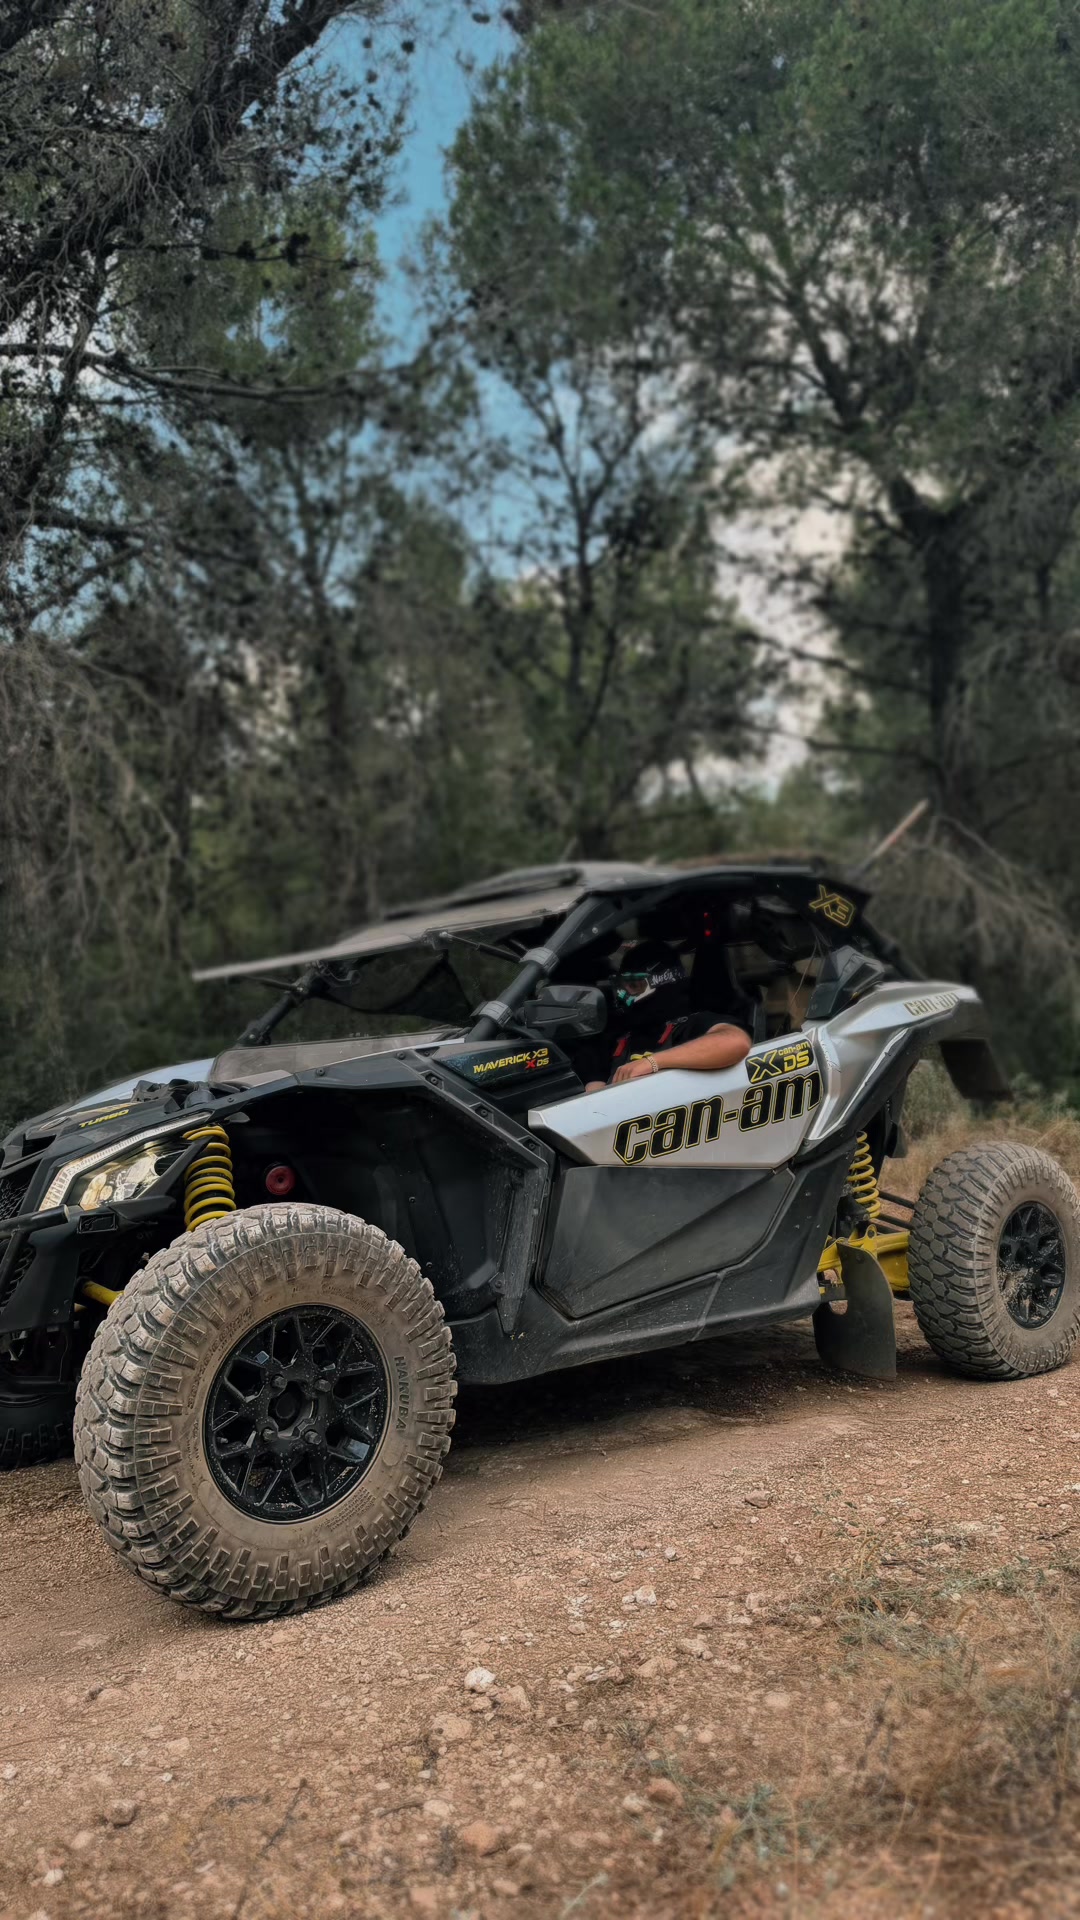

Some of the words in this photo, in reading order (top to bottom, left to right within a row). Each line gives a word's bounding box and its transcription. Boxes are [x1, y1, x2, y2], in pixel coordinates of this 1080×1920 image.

[809, 884, 855, 927] X3
[473, 1052, 531, 1073] MAVERICK
[532, 1048, 549, 1059] X3
[778, 1041, 811, 1056] can-am
[79, 1108, 130, 1128] TURBO
[613, 1070, 823, 1165] can-am
[393, 1356, 410, 1430] HAKUBA
